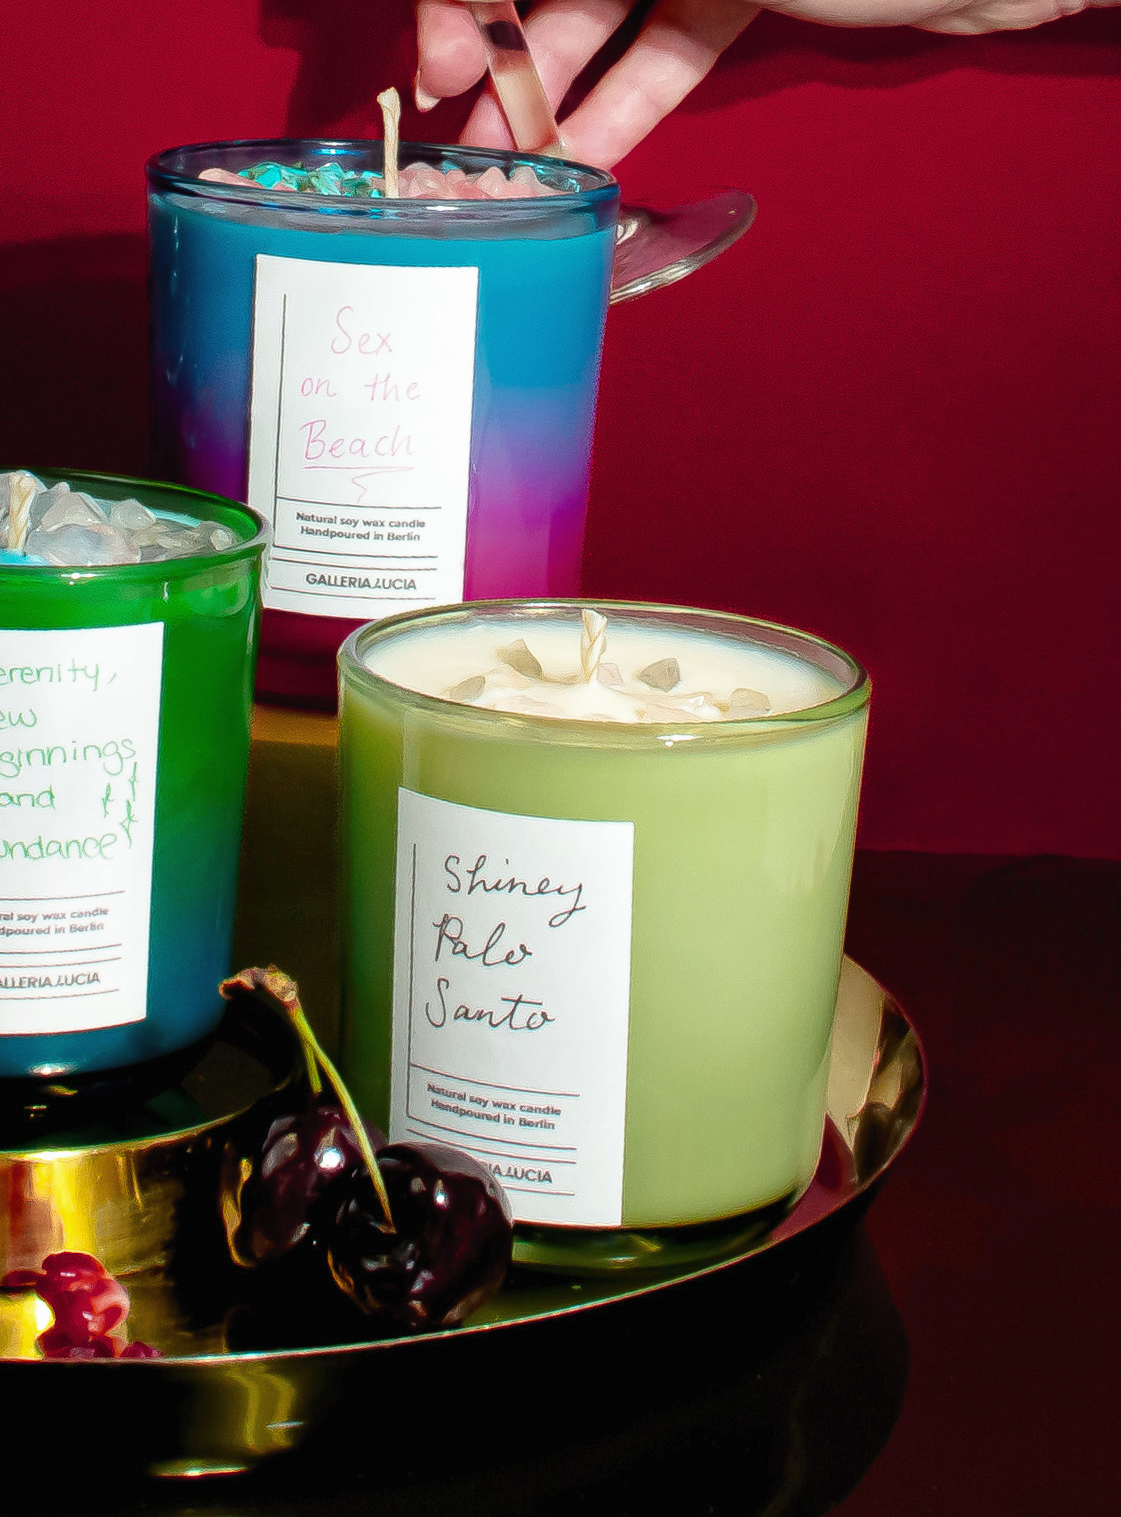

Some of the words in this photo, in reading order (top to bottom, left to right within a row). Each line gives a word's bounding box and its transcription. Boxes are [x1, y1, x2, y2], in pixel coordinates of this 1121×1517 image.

[330, 305, 393, 356] Sex
[300, 375, 337, 398] on
[364, 371, 421, 402] the
[299, 419, 417, 460] Beach
[296, 511, 337, 525] Natural
[340, 517, 360, 529] soy
[362, 519, 386, 528] wax
[389, 518, 426, 529] candle
[300, 525, 370, 540] Handpoured
[373, 530, 384, 541] in
[387, 531, 421, 542] Berlin
[444, 854, 587, 928] Shiney
[17, 912, 38, 923] soy
[42, 910, 66, 921] wax
[70, 906, 109, 919] candle
[54, 923, 65, 934] in
[69, 921, 104, 933] Berlin
[433, 913, 534, 967] Palo
[426, 977, 556, 1031] Santo
[427, 1082, 466, 1101] Natural
[469, 1094, 489, 1108] soy
[492, 1099, 517, 1111] wax
[519, 1103, 562, 1116] candle
[431, 1098, 500, 1123] Handpoured
[503, 1113, 515, 1125] in
[519, 1117, 555, 1130] Berlin
